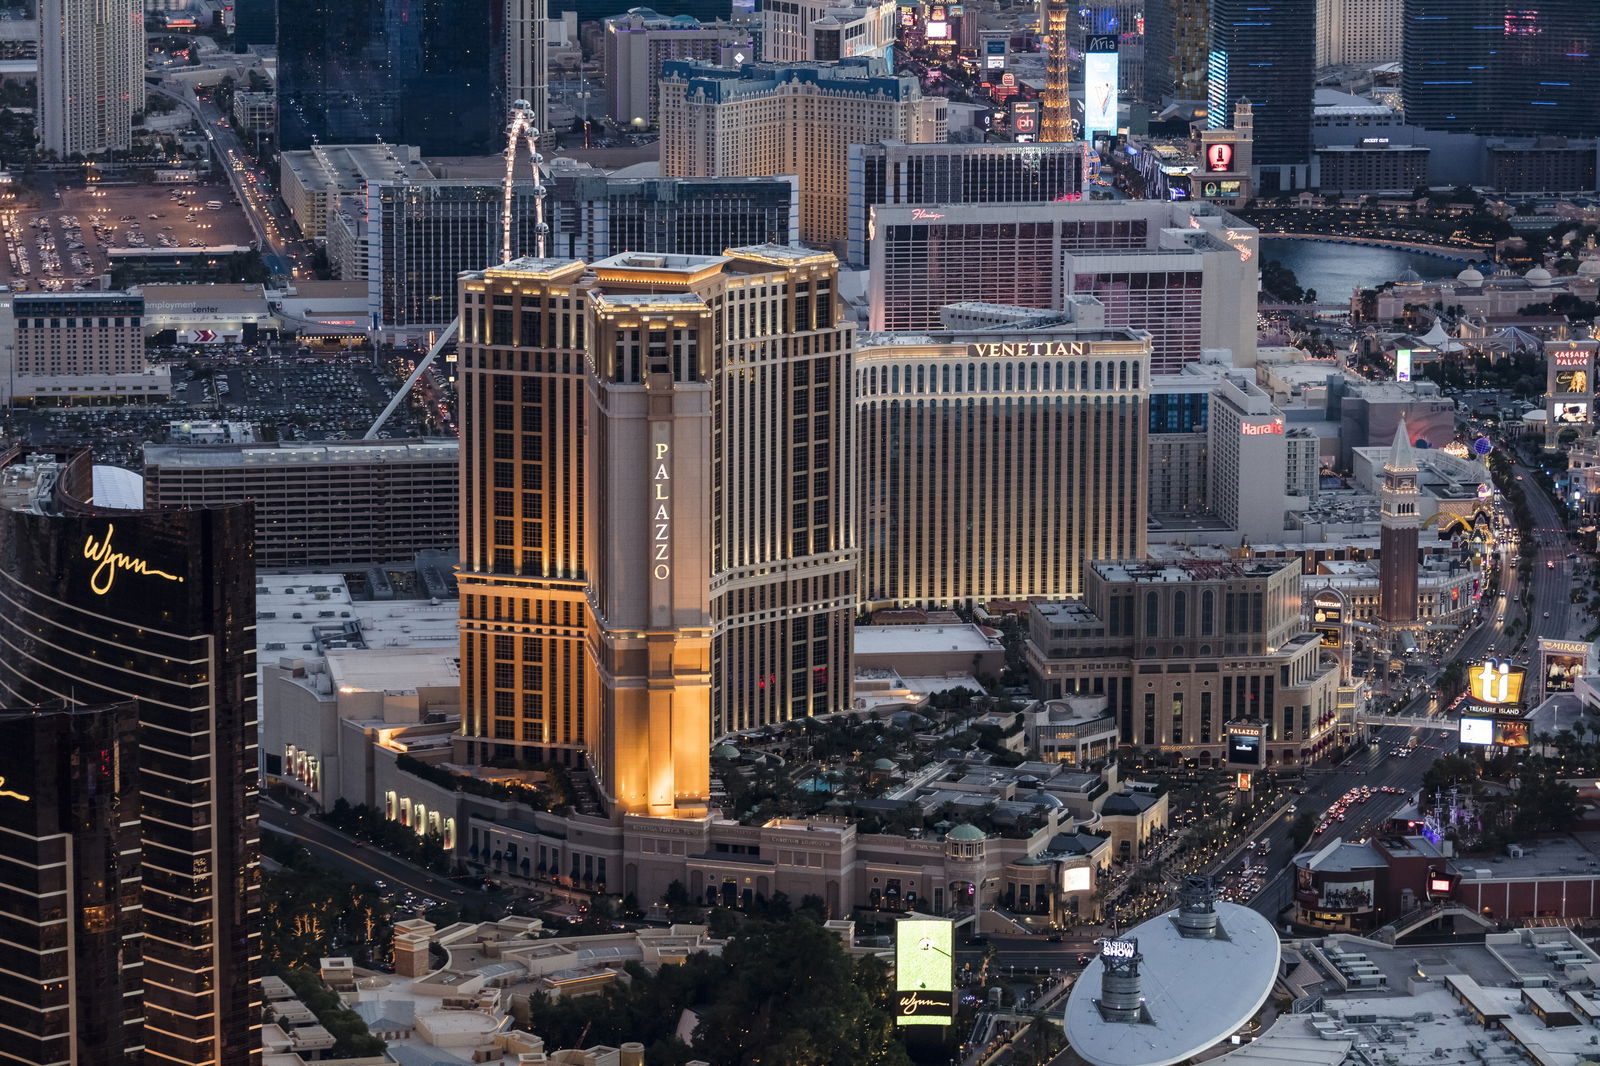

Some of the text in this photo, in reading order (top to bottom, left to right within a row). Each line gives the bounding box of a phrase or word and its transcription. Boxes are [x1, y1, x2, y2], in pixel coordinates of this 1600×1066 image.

[1090, 37, 1115, 50] Aria
[912, 208, 945, 220] Flamingo
[1226, 230, 1253, 241] Flamingo
[974, 342, 1083, 357] VENETIAN
[654, 443, 670, 580] PALAZZO
[1553, 642, 1588, 652] MIRAGE
[1499, 707, 1520, 715] ISLAND
[1229, 728, 1259, 736] PALAZZO
[1103, 940, 1135, 950] FASHION
[1103, 947, 1135, 958] SHOW
